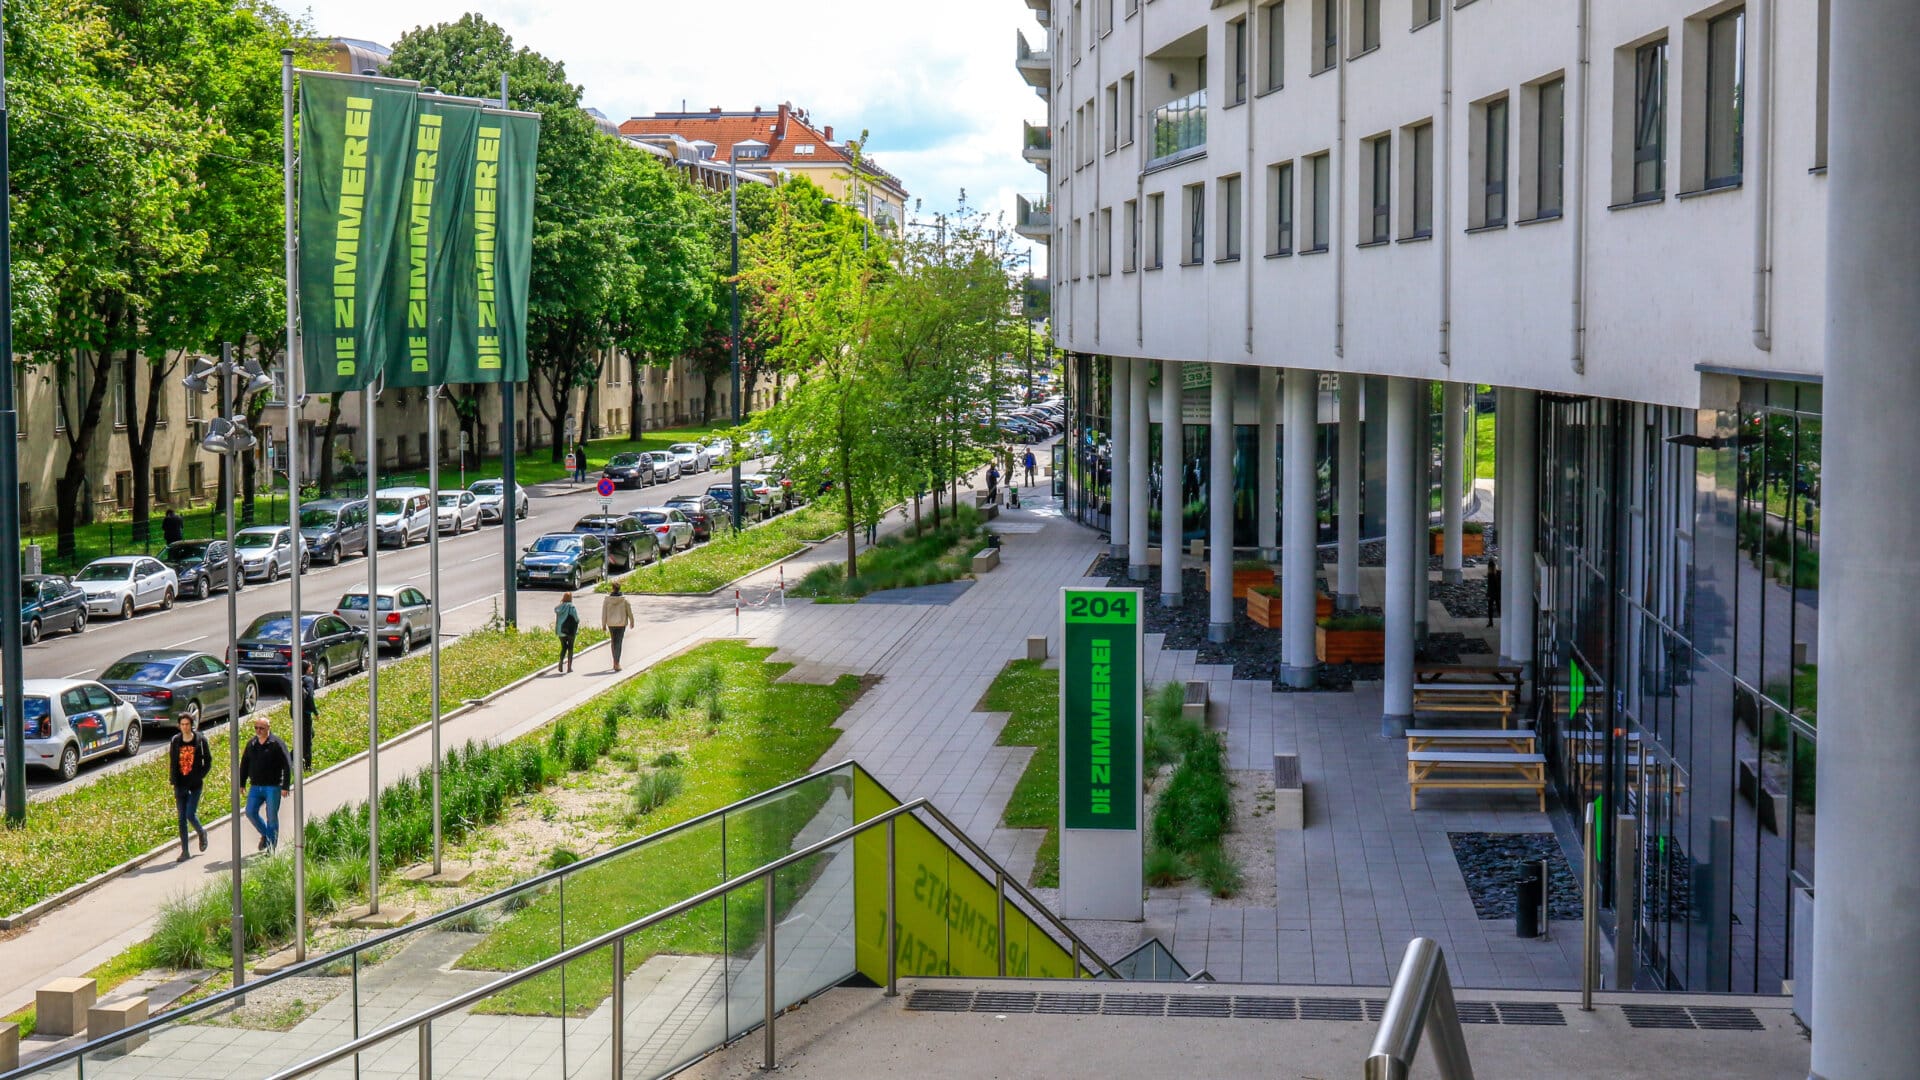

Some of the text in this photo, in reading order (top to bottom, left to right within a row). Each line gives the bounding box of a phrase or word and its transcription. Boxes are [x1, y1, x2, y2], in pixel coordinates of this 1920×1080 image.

[333, 96, 373, 376] DIE ZIMMEREI
[408, 114, 443, 372] DIE ZIMMEREI
[474, 127, 501, 369] DIE ZIMMEREI
[1071, 597, 1130, 618] 204
[1091, 638, 1111, 814] DIE ZIMMEREI
